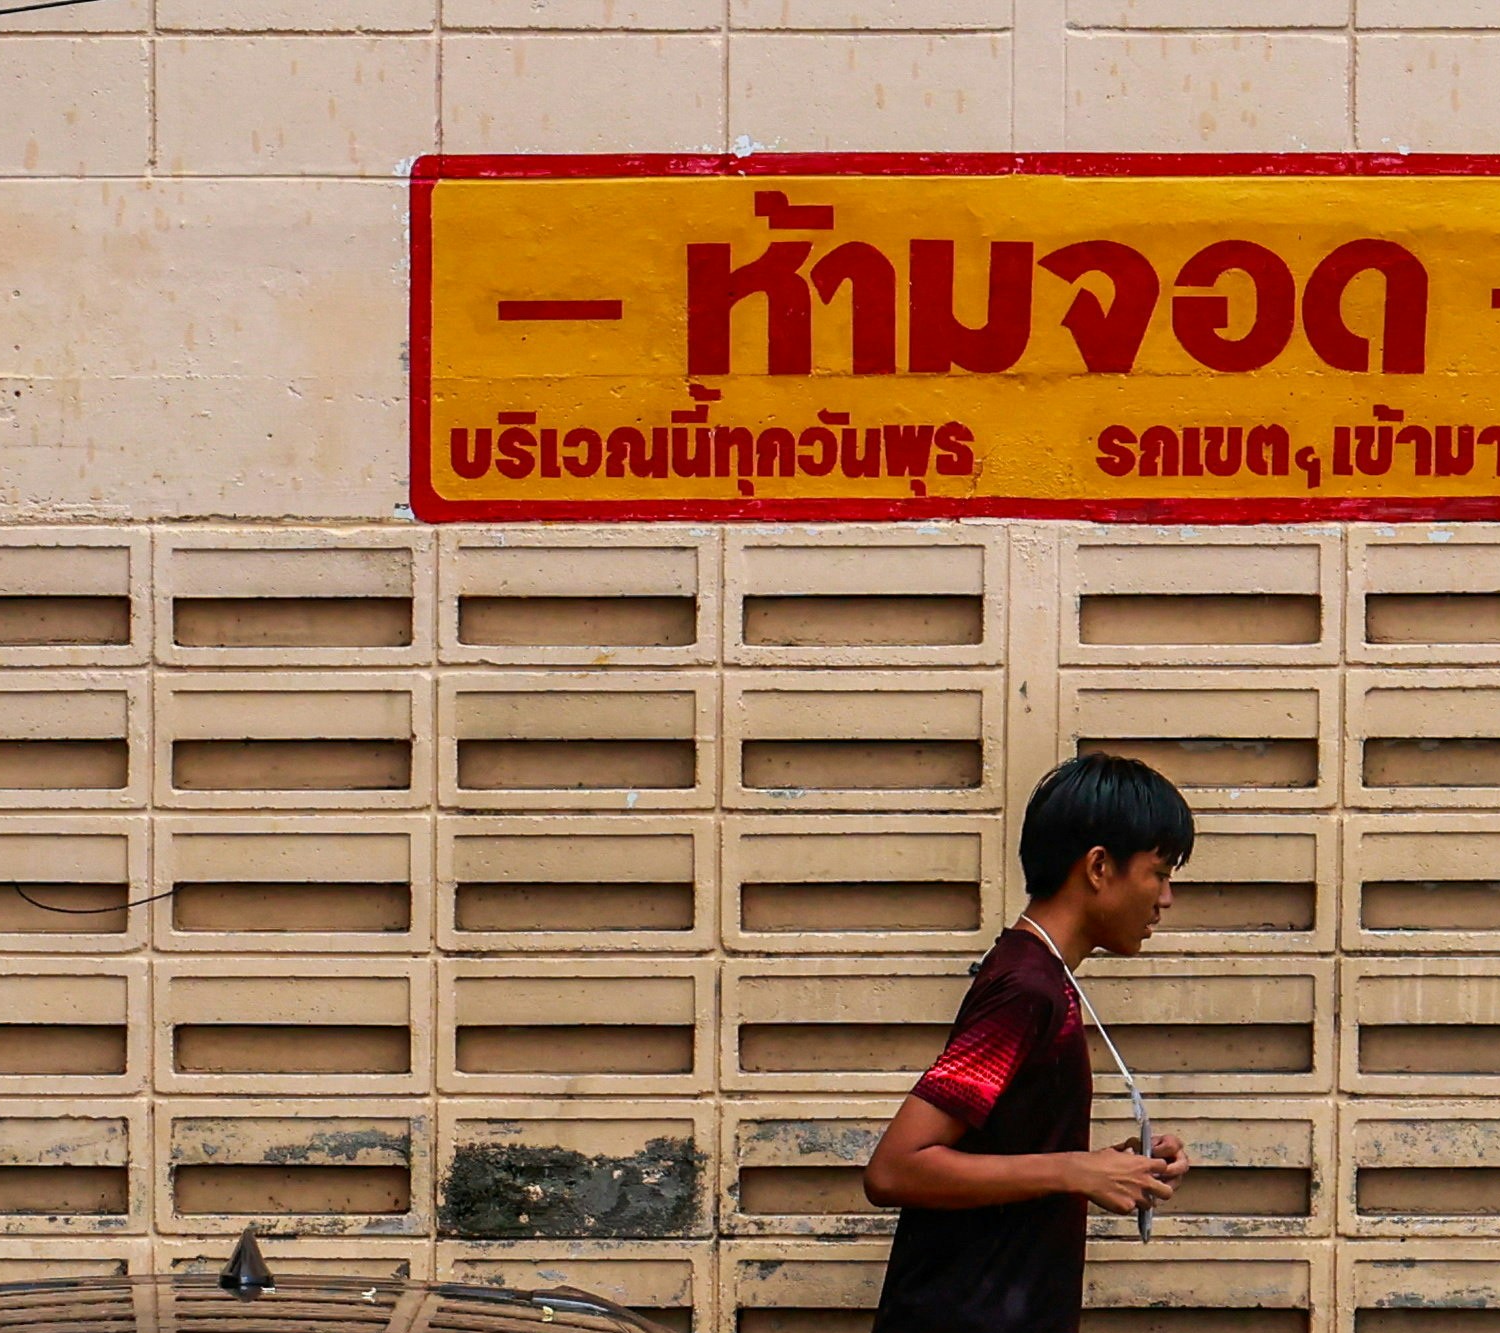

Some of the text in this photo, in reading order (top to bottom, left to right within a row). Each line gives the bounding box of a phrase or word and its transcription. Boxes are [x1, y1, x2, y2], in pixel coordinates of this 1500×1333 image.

[686, 190, 1429, 378] ห้ามจอด
[450, 383, 975, 498] บริเวณนี้ทุกวันพุธ
